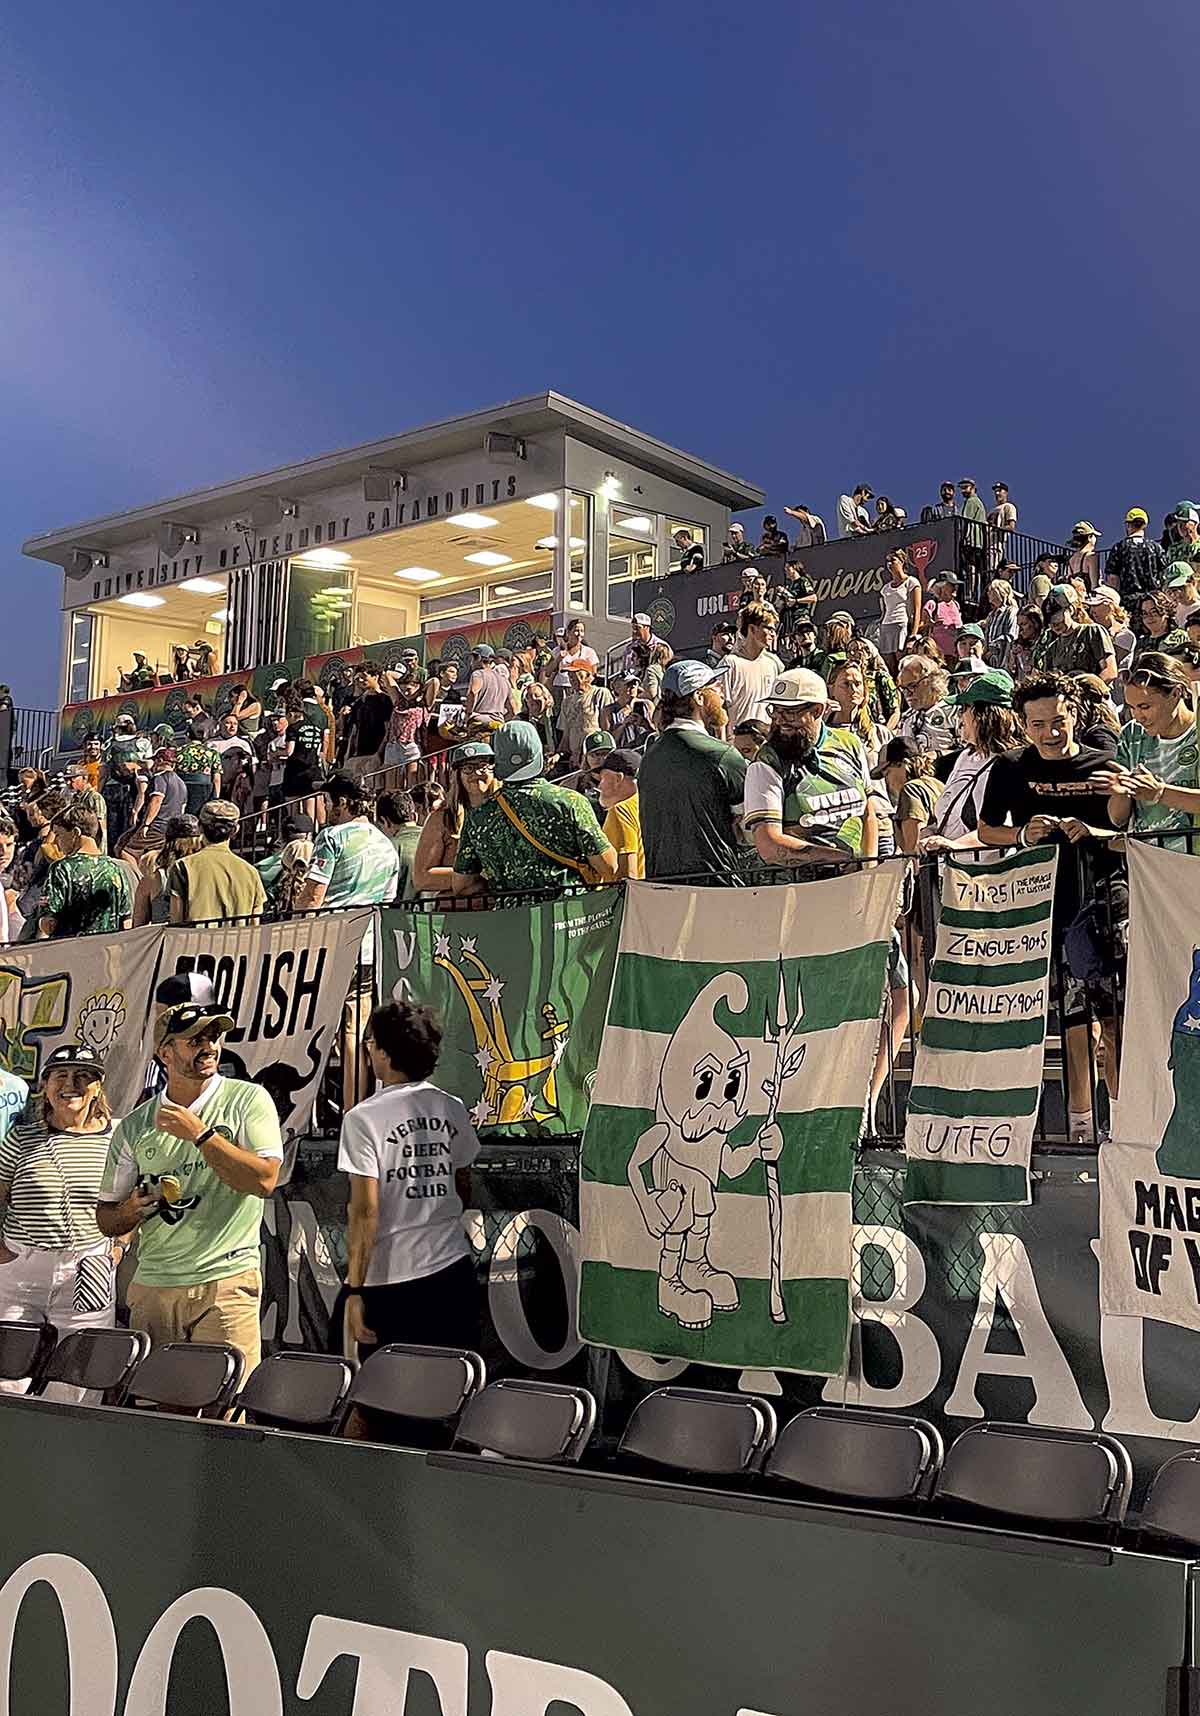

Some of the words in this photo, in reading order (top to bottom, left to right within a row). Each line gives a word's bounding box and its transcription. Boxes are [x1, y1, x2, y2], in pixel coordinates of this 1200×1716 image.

[220, 545, 241, 568] OF
[258, 517, 351, 558] VERMONT
[366, 475, 516, 531] CATAMOUNTS
[175, 947, 328, 1043] OLISH
[925, 1123, 1012, 1158] UTFG
[1128, 1230, 1173, 1296] OF
